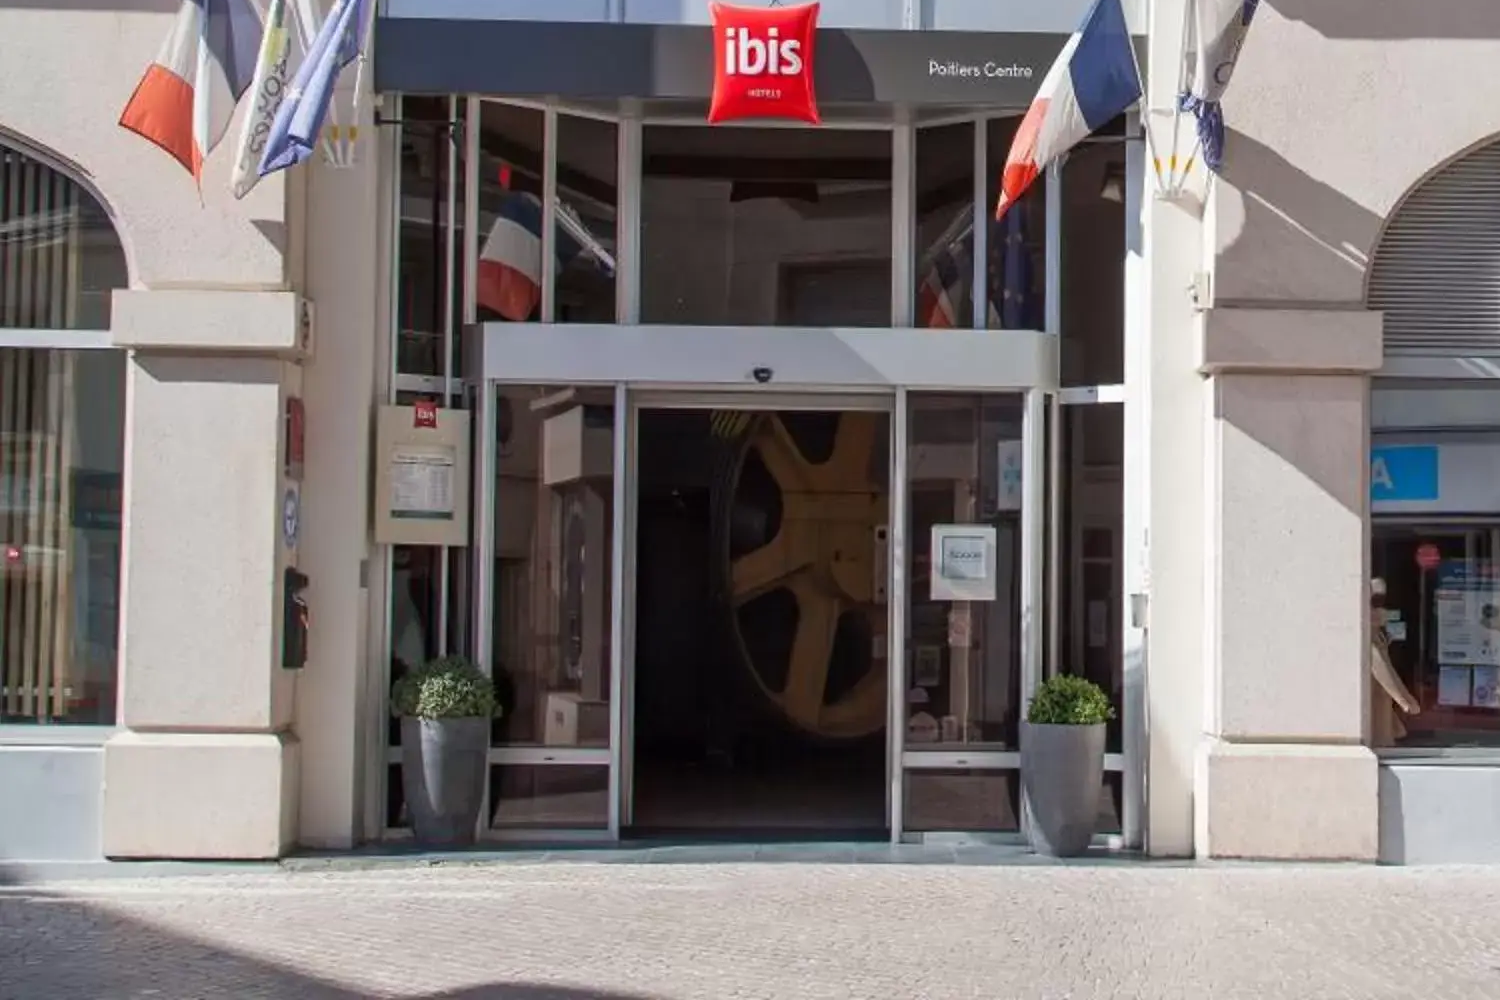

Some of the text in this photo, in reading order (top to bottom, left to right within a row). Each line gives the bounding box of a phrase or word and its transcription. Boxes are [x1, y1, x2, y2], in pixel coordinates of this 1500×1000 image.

[725, 26, 803, 75] ibis
[928, 60, 1033, 78] Poitiers Centre
